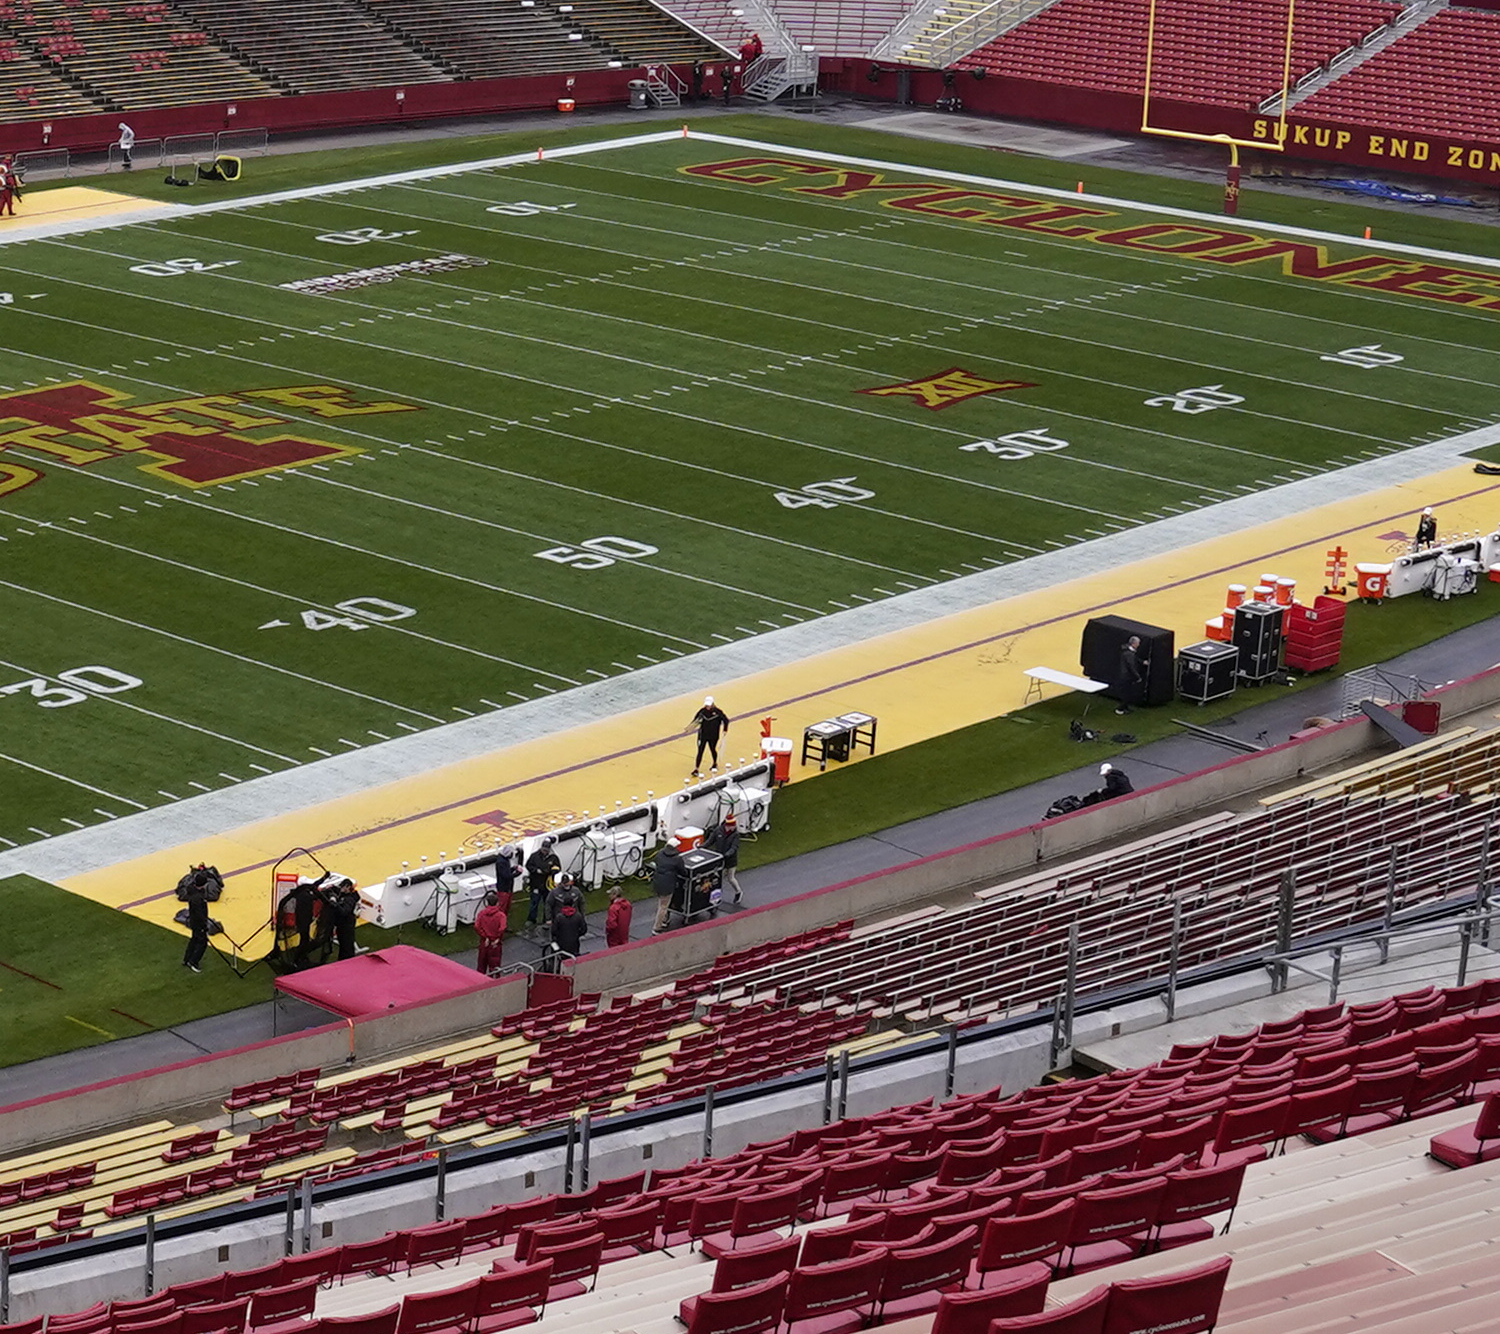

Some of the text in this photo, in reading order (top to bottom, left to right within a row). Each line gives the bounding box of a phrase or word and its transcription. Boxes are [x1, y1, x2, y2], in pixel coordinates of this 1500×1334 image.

[1253, 118, 1352, 151] SUKUP
[1368, 135, 1430, 162] END
[1319, 347, 1404, 369] 10
[1143, 388, 1246, 414] 20
[959, 432, 1070, 459] 30
[774, 480, 876, 509] 40
[533, 536, 660, 570] 50
[300, 597, 418, 631] 40
